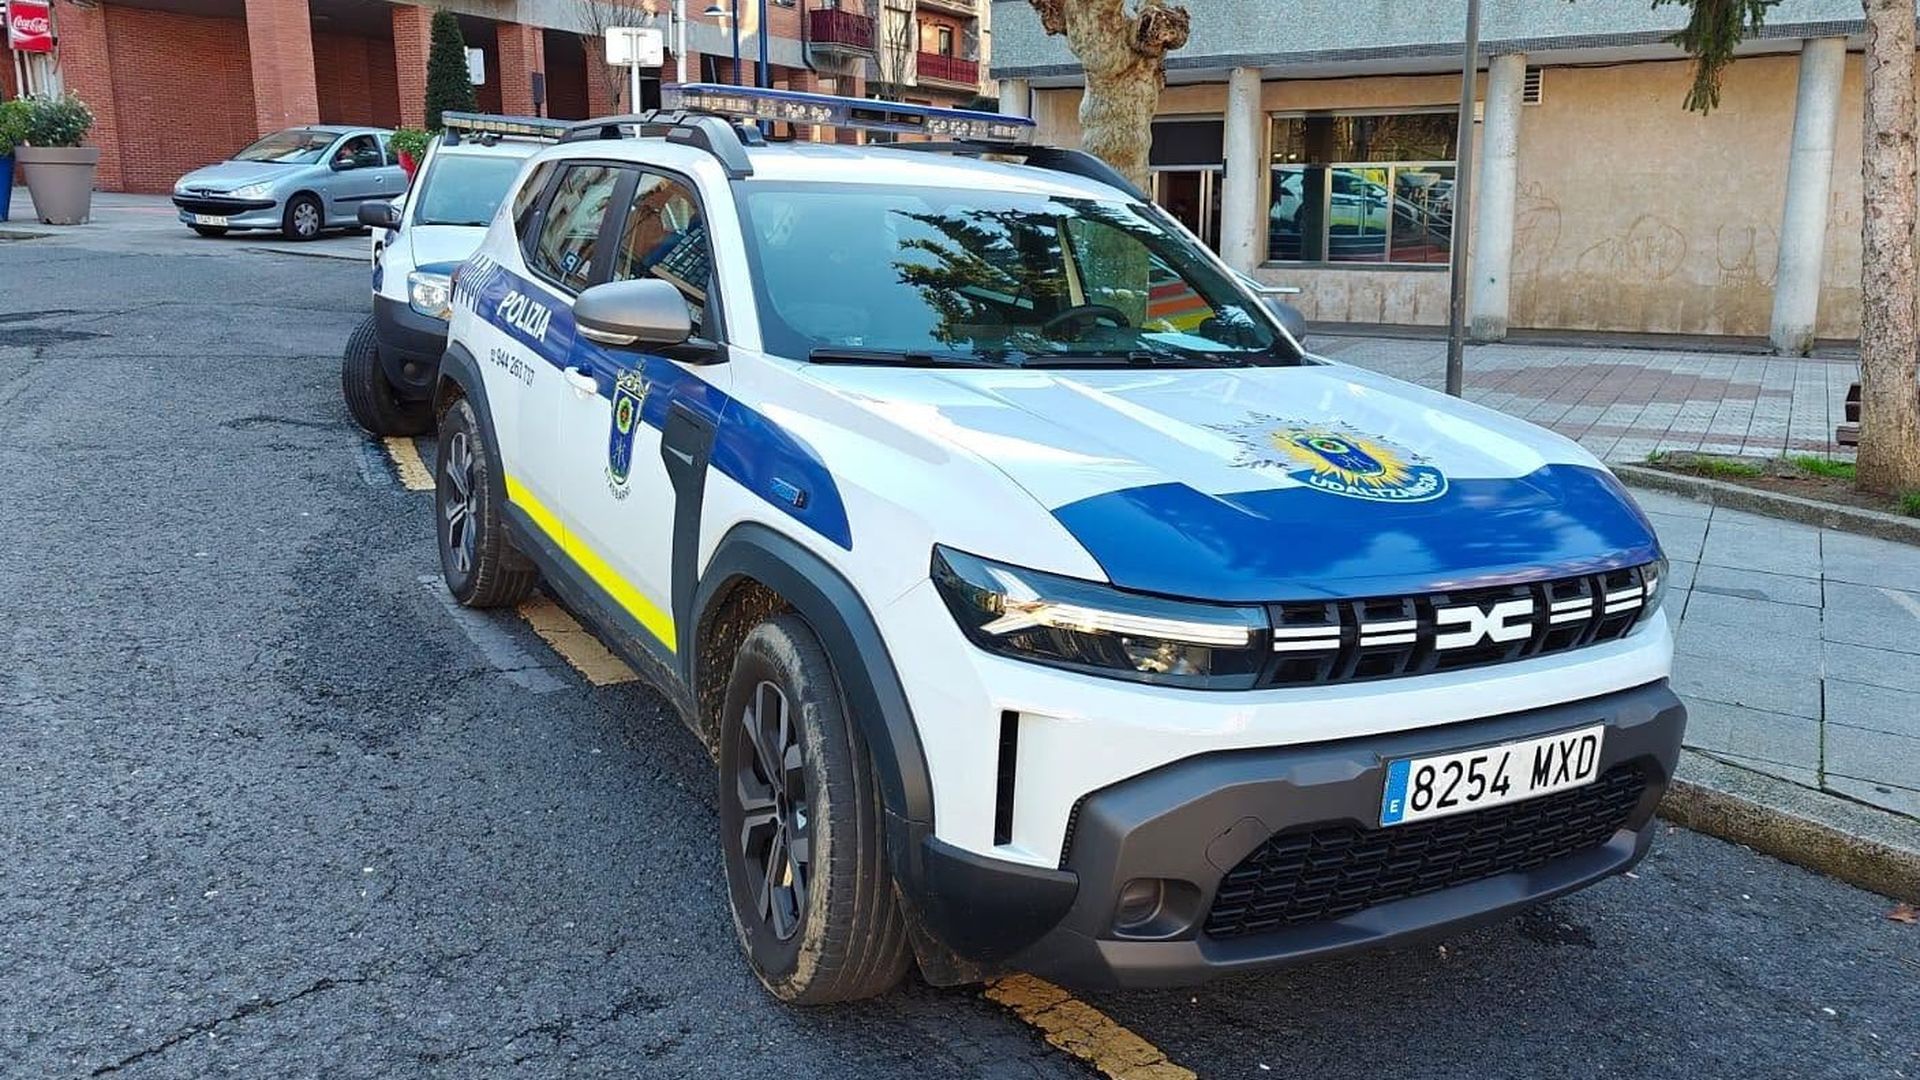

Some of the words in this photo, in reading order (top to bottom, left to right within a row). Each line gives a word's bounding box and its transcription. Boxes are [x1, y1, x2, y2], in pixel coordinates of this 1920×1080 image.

[496, 290, 552, 343] POLIZIA
[496, 348, 509, 369] 944
[1389, 799, 1399, 813] E
[1411, 751, 1511, 812] 8254
[1530, 734, 1597, 791] MXD
